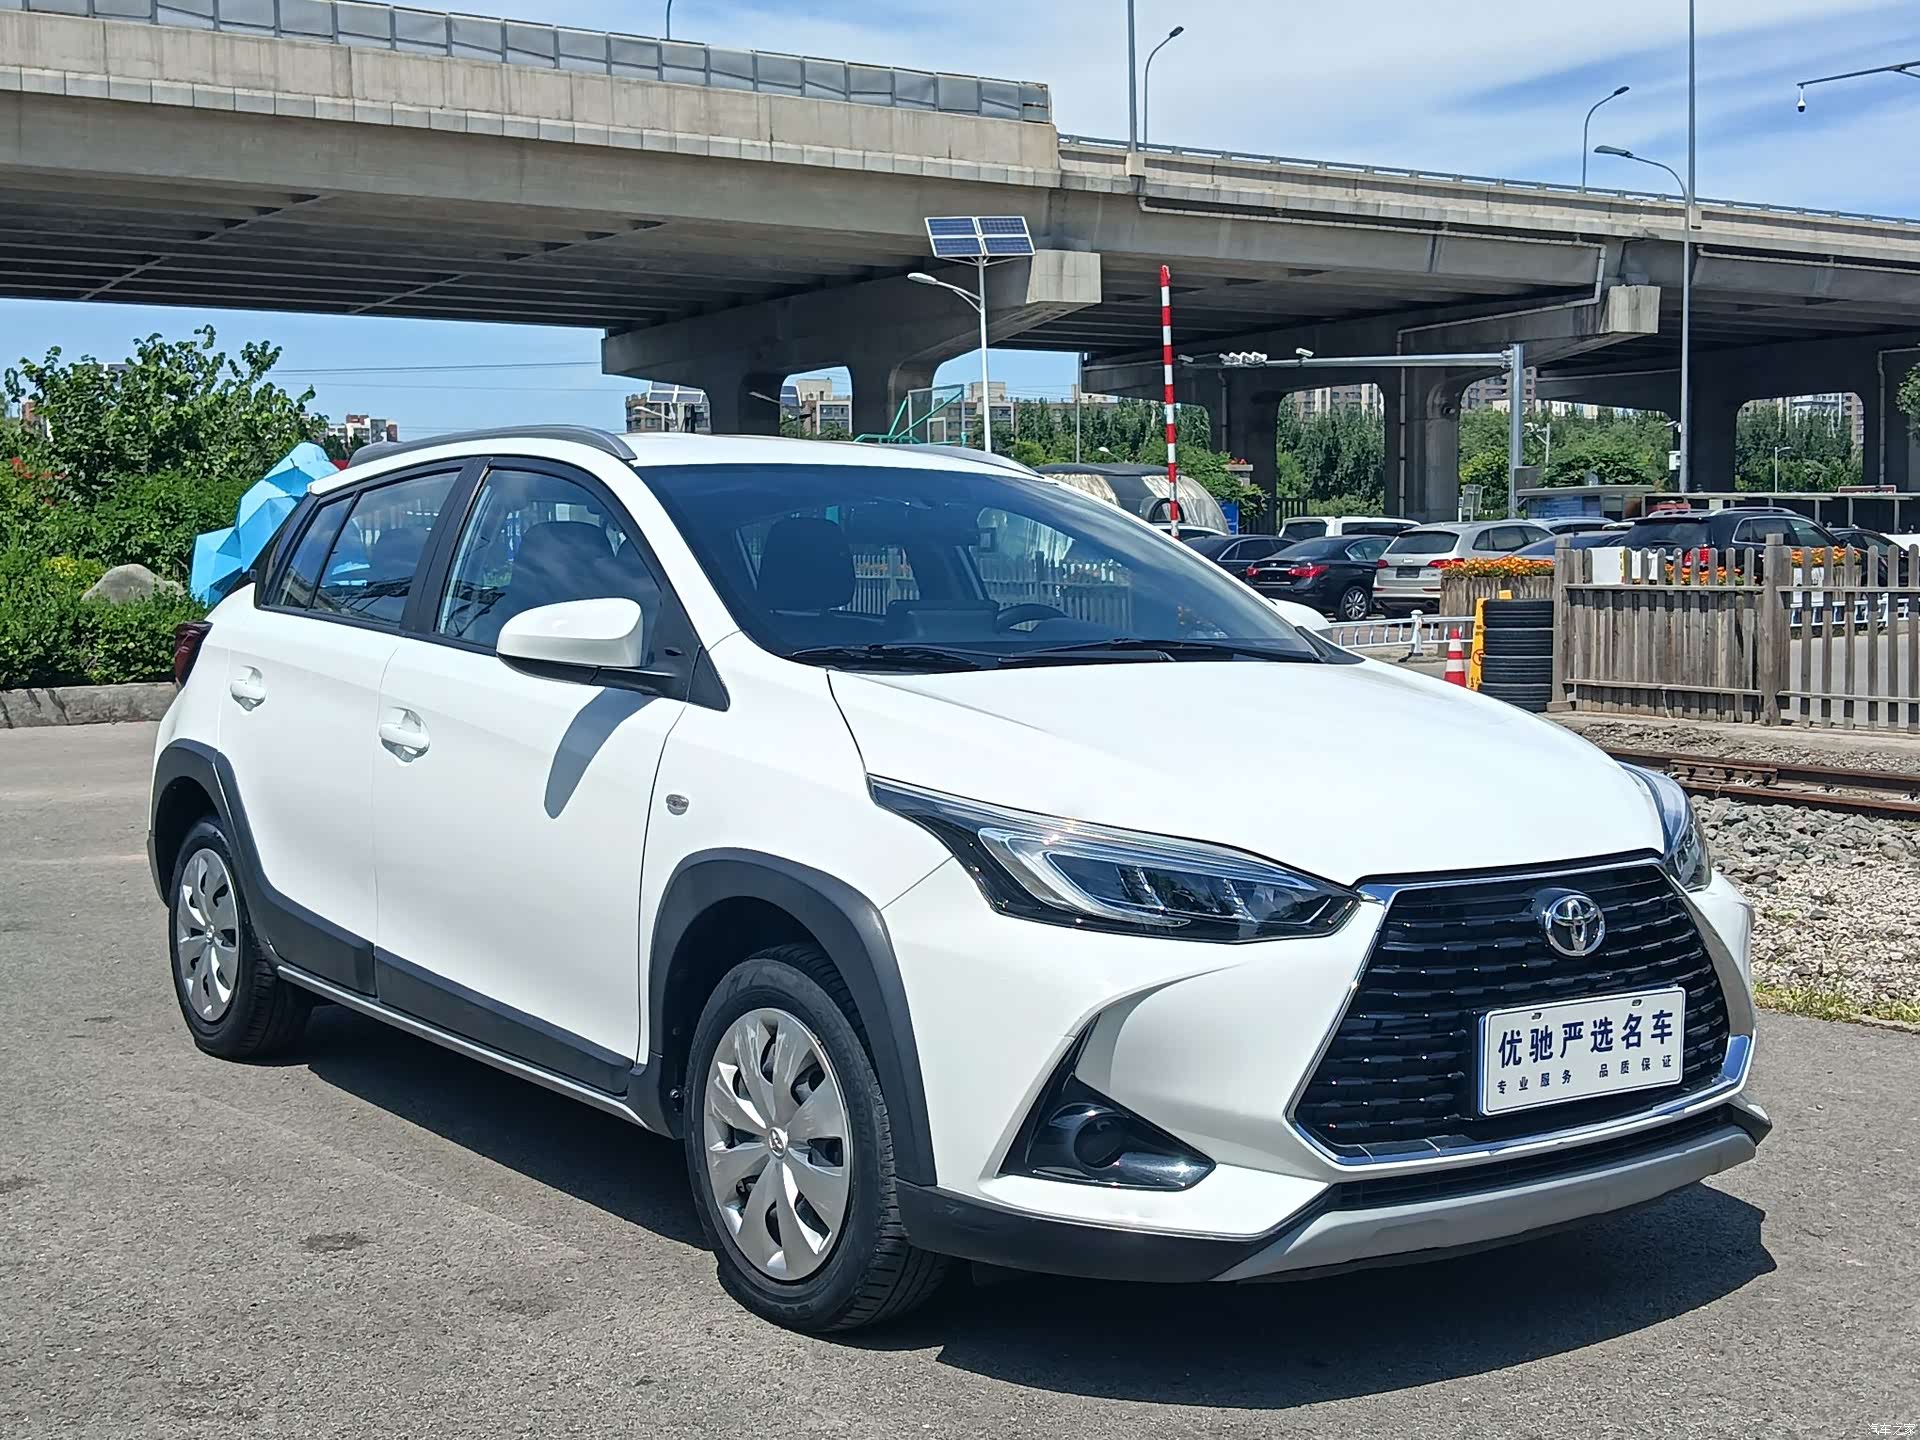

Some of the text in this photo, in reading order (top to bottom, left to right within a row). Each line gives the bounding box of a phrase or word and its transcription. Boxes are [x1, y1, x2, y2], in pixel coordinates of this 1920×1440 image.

[1498, 1009, 1673, 1068] 优驰严选名车
[1497, 1054, 1672, 1094] 专业服务 品质保证
